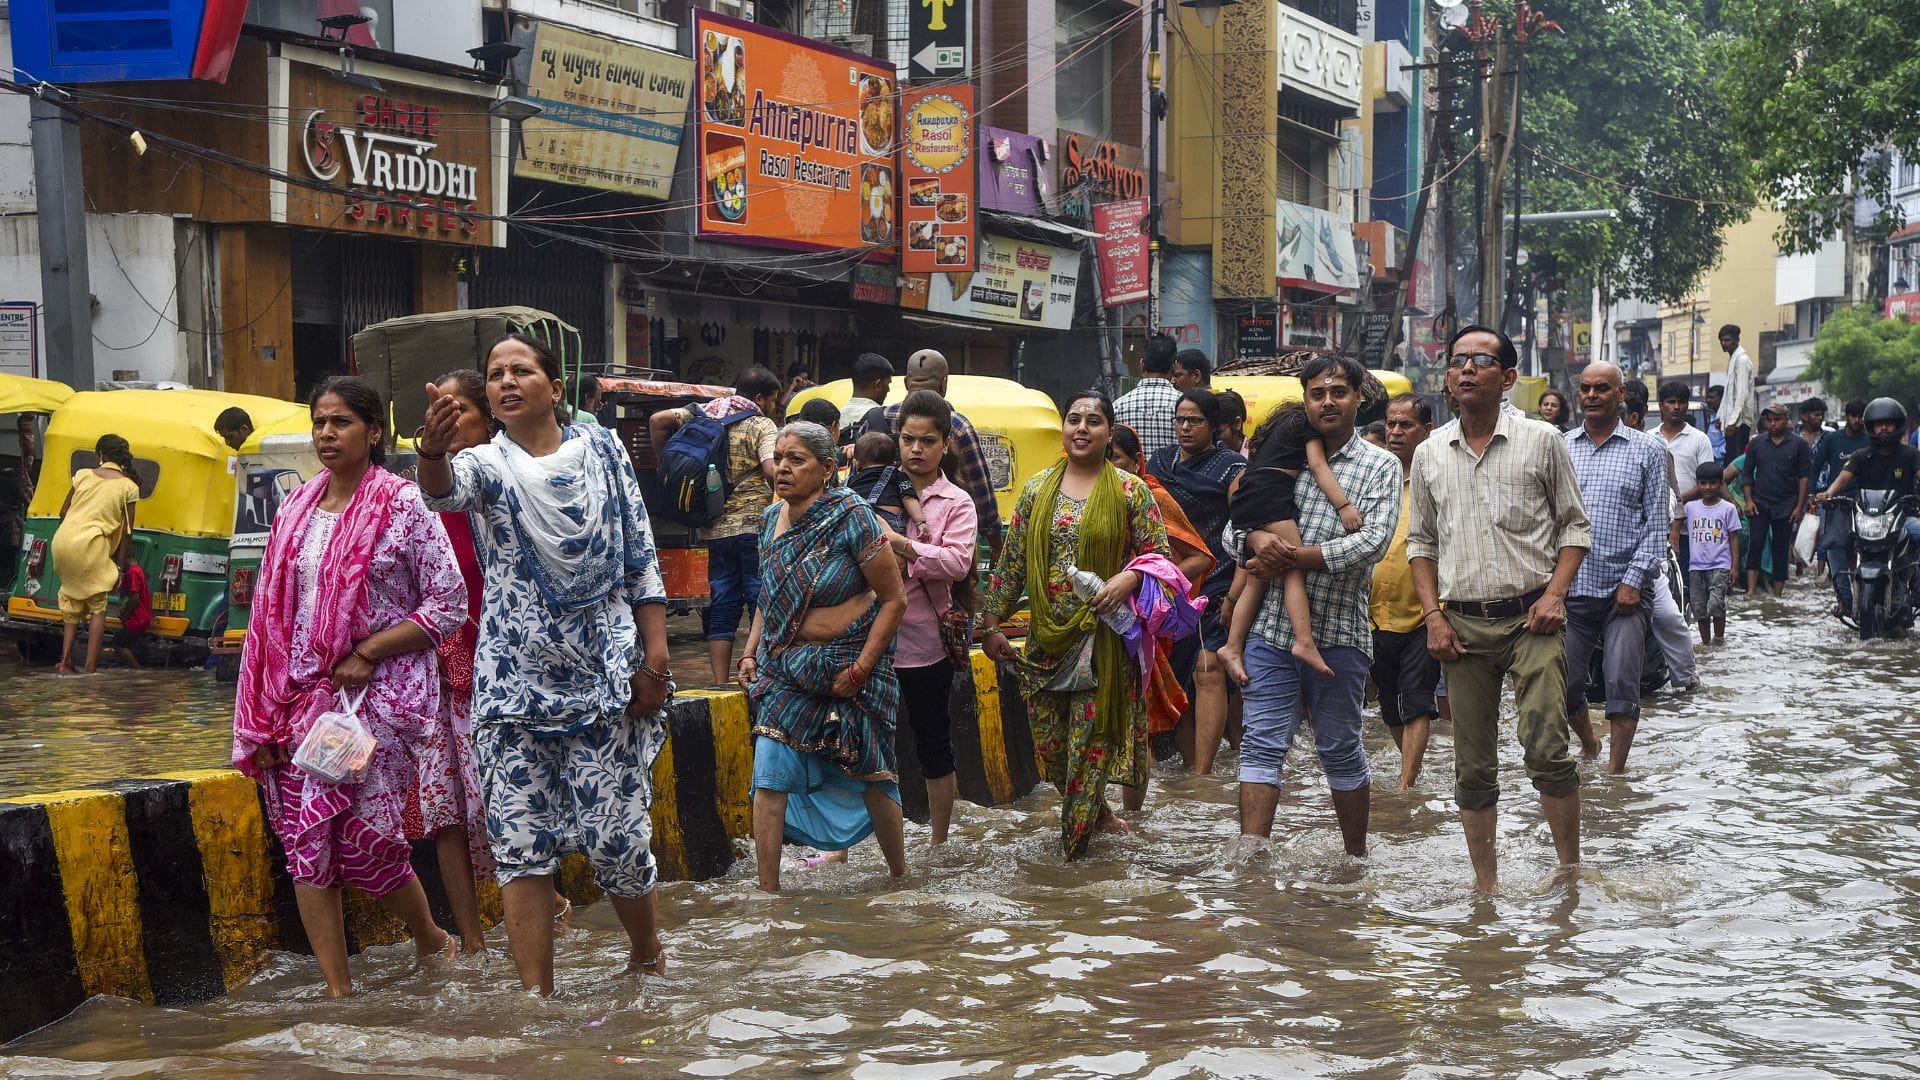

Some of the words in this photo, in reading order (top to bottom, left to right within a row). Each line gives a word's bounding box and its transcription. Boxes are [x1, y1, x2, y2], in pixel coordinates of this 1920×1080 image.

[363, 95, 440, 136] SHREE
[749, 89, 858, 155] Annapurna
[917, 113, 960, 127] Annapurna
[922, 129, 952, 141] Rasoi
[340, 127, 477, 200] VRIDDHI
[915, 143, 959, 154] Restaurant
[1065, 133, 1146, 199] Saffron
[760, 149, 790, 179] Rasoi
[794, 155, 851, 191] Restaurant
[350, 188, 478, 234] SAREES
[1692, 518, 1723, 530] WILD
